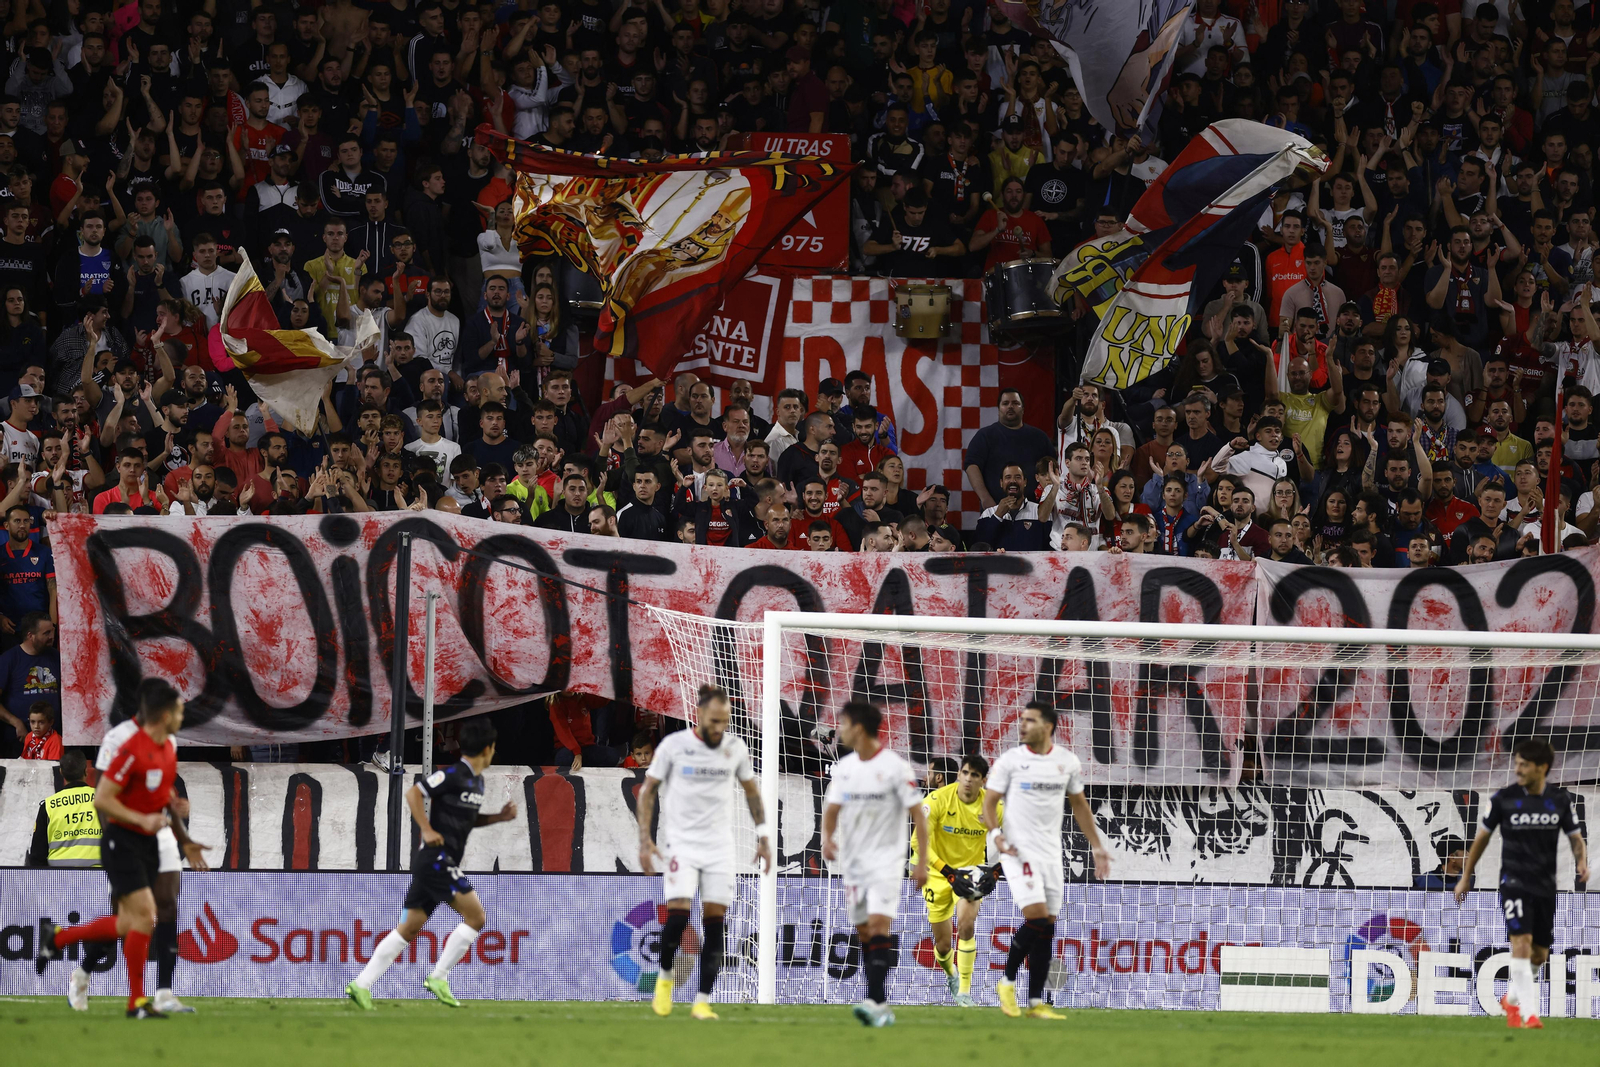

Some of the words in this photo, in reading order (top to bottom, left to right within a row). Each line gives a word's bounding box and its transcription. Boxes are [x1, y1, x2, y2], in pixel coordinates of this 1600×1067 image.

[618, 85, 636, 93] DEGIR
[764, 137, 834, 157] ULTRAS
[774, 235, 824, 254] 975
[80, 272, 111, 280] ARATHO
[1277, 272, 1304, 281] betfair
[4, 571, 42, 579] ARATHON
[13, 577, 28, 585] BET
[50, 792, 96, 809] SEGURIDA
[64, 811, 93, 825] 1575
[1510, 813, 1560, 826] CAZOO
[953, 826, 985, 837] DEGIRO
[669, 855, 679, 873] 6
[1022, 861, 1033, 878] 4
[1504, 898, 1524, 920] 21
